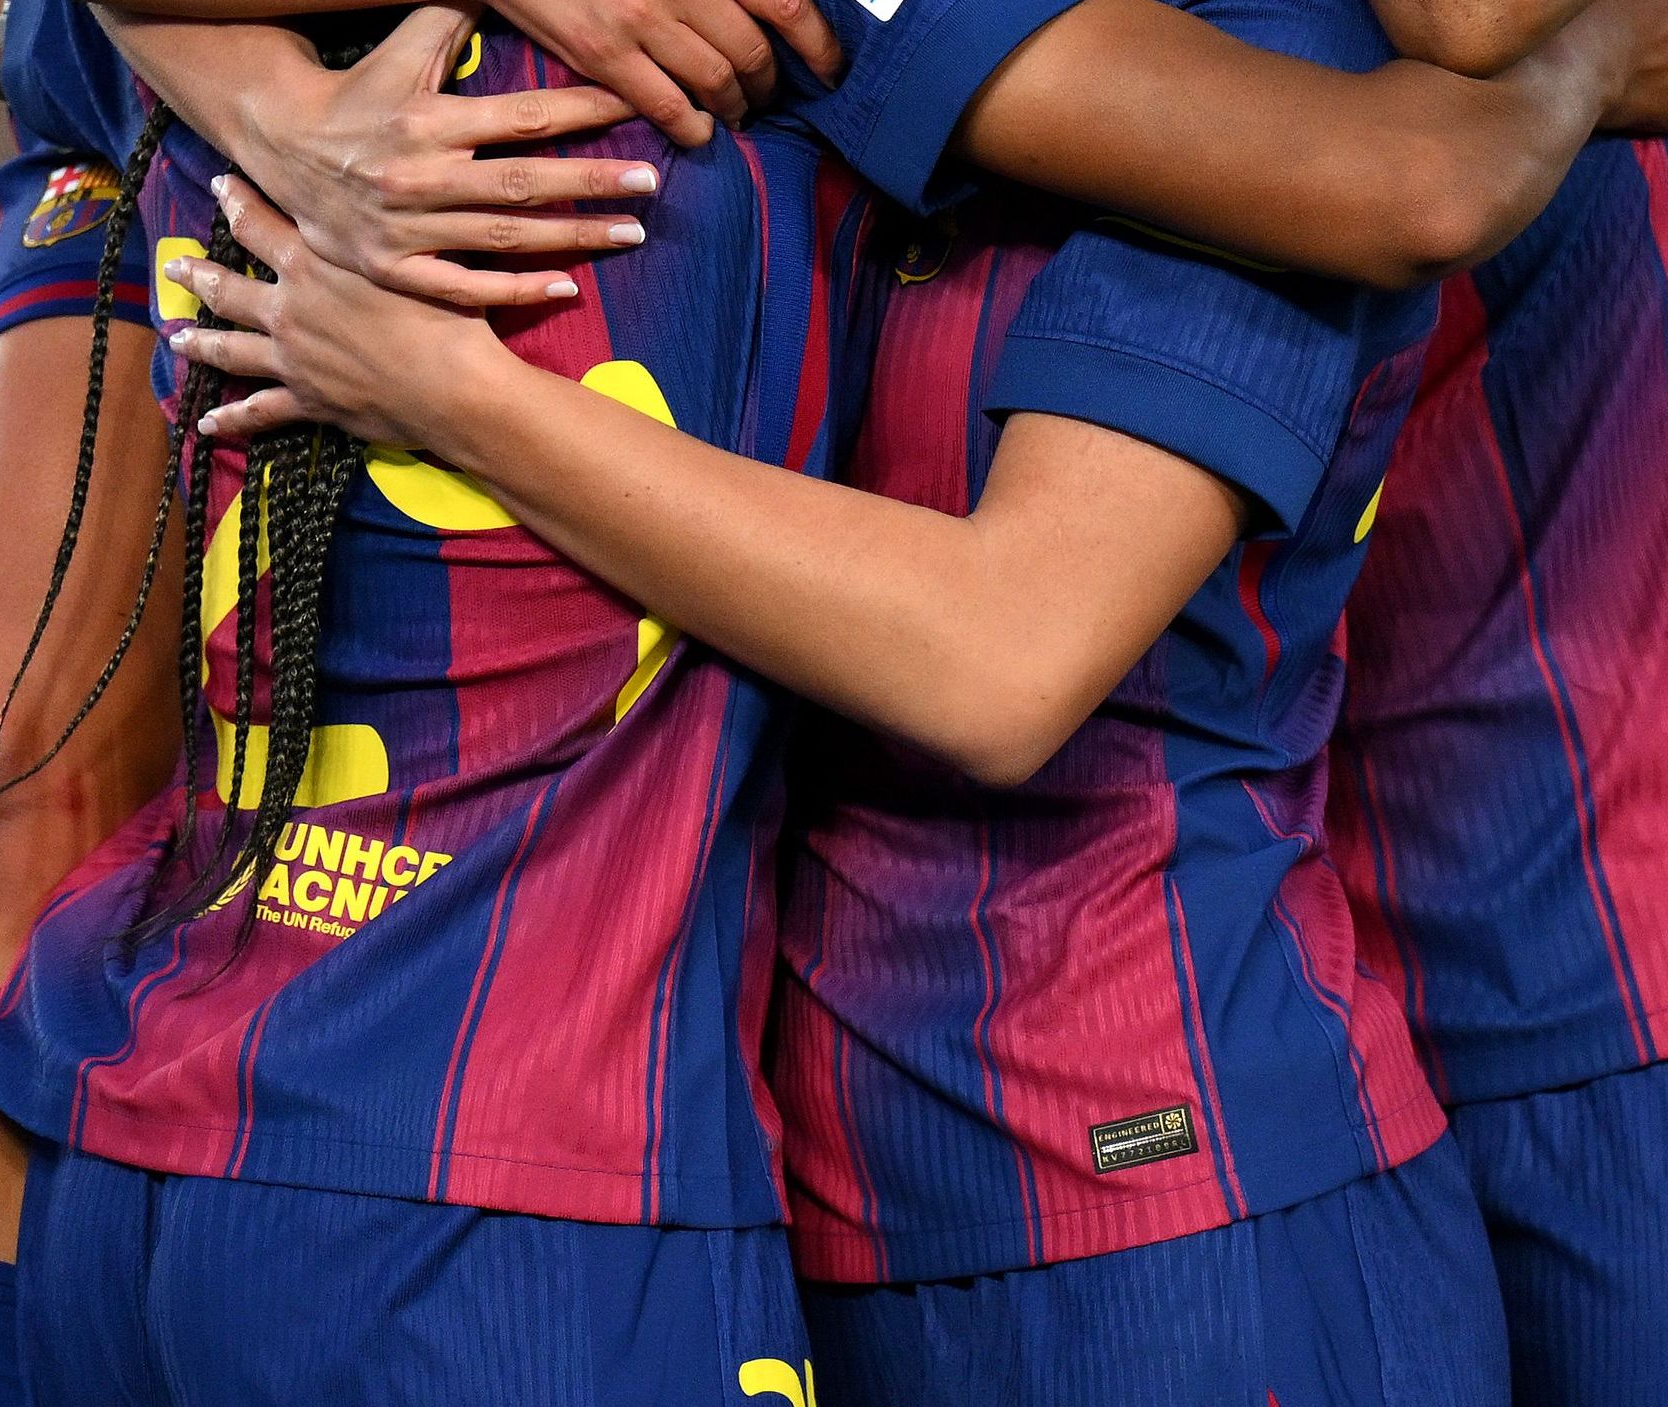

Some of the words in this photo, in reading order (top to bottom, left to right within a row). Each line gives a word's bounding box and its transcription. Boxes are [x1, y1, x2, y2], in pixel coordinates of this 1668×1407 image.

[256, 904, 281, 923] The
[282, 911, 309, 930] UN
[1098, 1121, 1160, 1143] ENGINEERED
